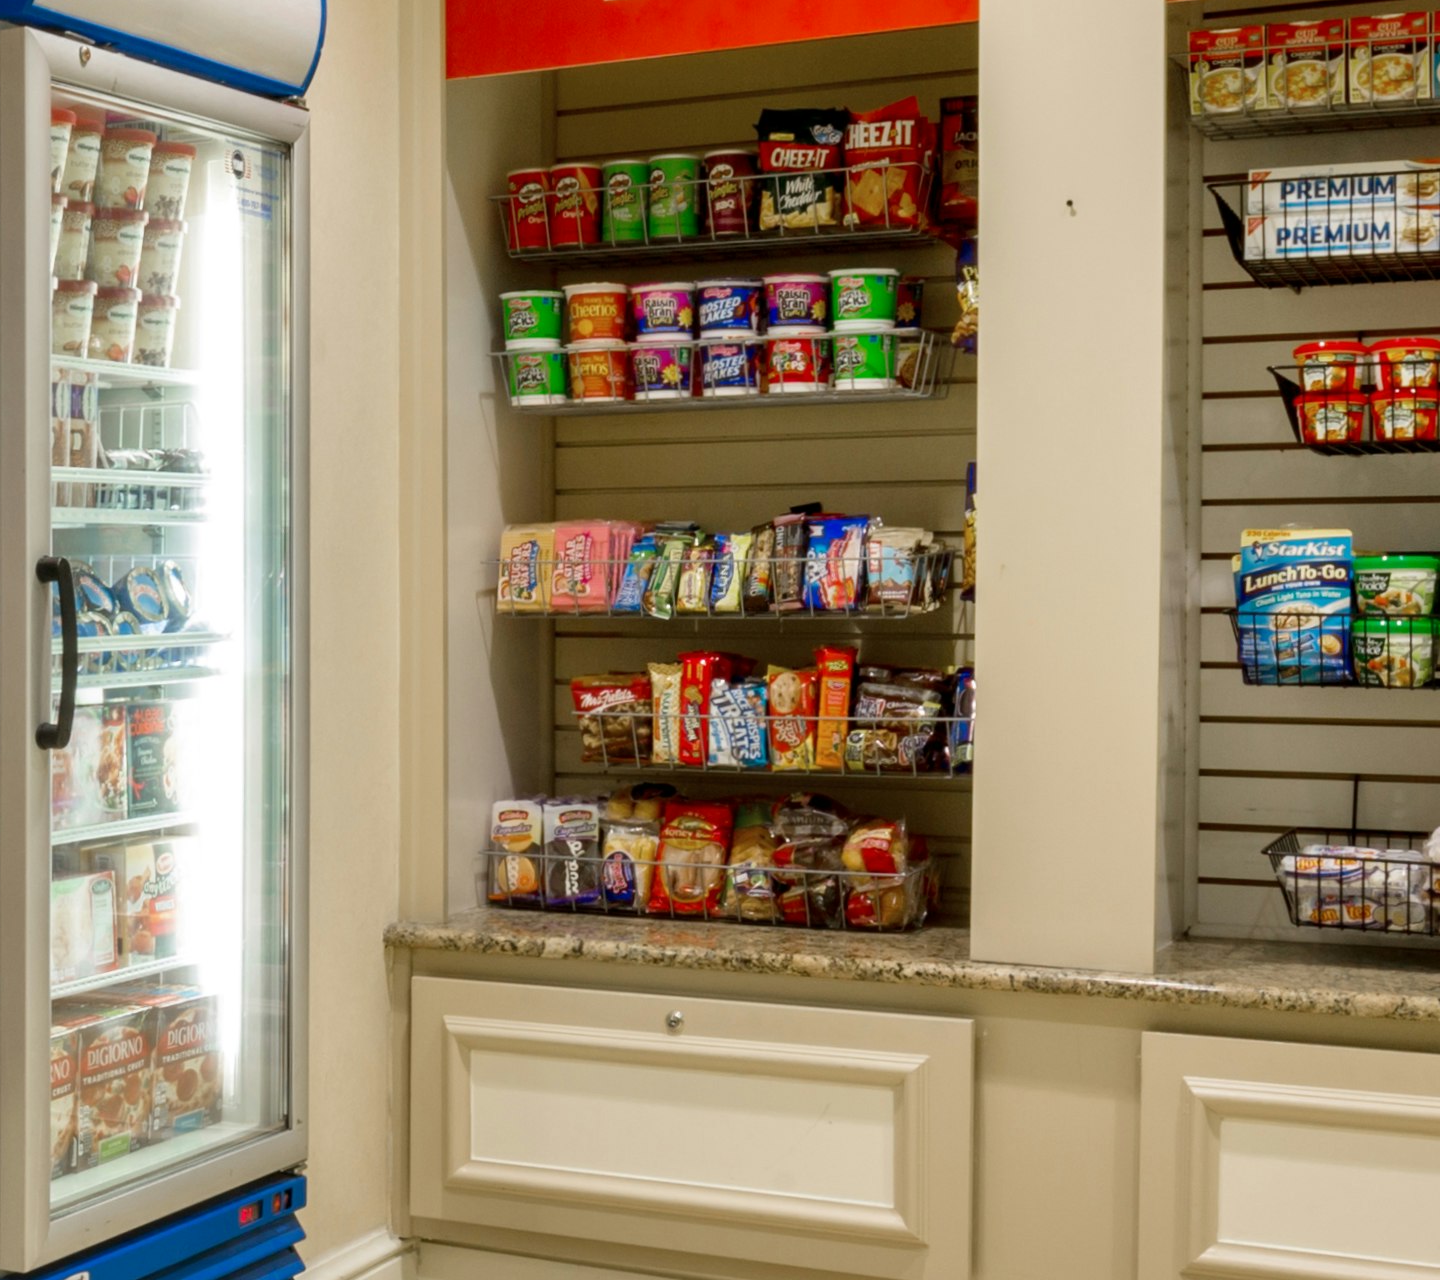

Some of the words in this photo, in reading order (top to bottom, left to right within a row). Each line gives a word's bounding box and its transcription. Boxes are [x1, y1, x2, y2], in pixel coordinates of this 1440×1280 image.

[771, 147, 830, 169] CHEEZ-IT
[785, 176, 814, 193] White
[1280, 176, 1395, 202] PREMIUM
[1276, 222, 1391, 247] PREMIUM
[778, 289, 809, 302] Raisin
[572, 304, 618, 318] Cheerios
[645, 299, 676, 311] Raisin
[781, 300, 807, 311] Bran
[1266, 542, 1346, 558] StarKist
[87, 1035, 143, 1068] DIGIORNO
[162, 1047, 203, 1064] TRADITIONAL
[83, 1068, 126, 1087] TRADITIONAL
[127, 1058, 145, 1073] CRUST
